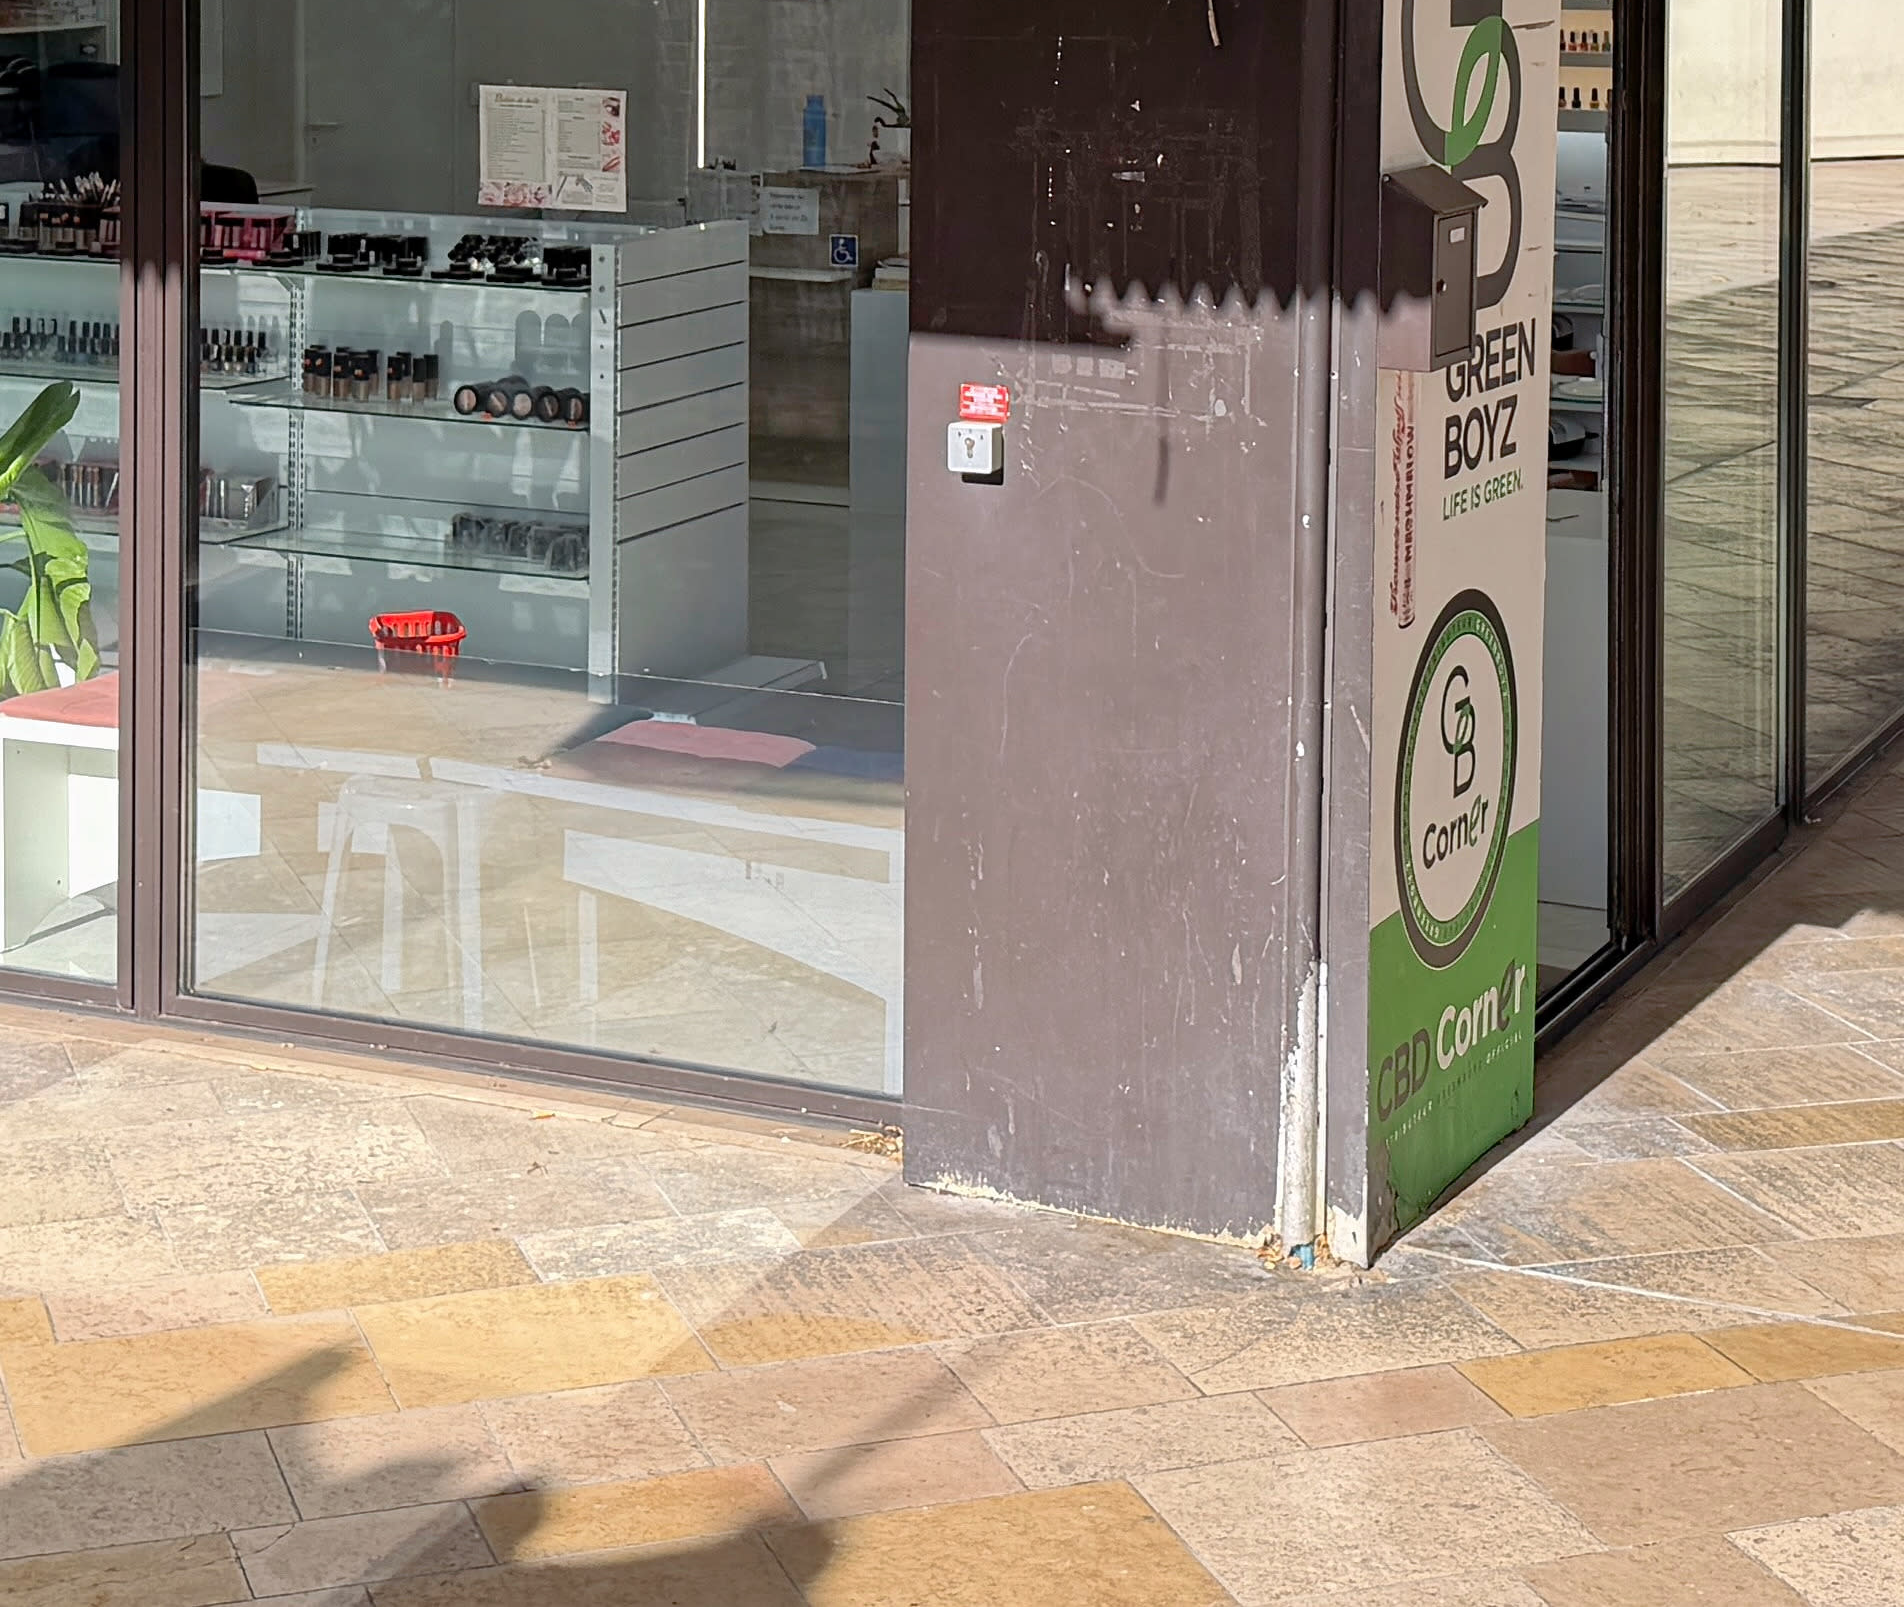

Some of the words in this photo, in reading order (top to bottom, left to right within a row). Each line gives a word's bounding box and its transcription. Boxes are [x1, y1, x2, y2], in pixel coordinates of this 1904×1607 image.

[1445, 317, 1537, 403] GREEN
[1444, 393, 1519, 481] BOYZ
[1442, 489, 1468, 522] LIFE
[1469, 484, 1482, 510] IS
[1483, 466, 1524, 505] GREEN.
[1422, 794, 1489, 870] Corner
[1376, 1027, 1431, 1123] CBD
[1436, 959, 1526, 1071] Corner
